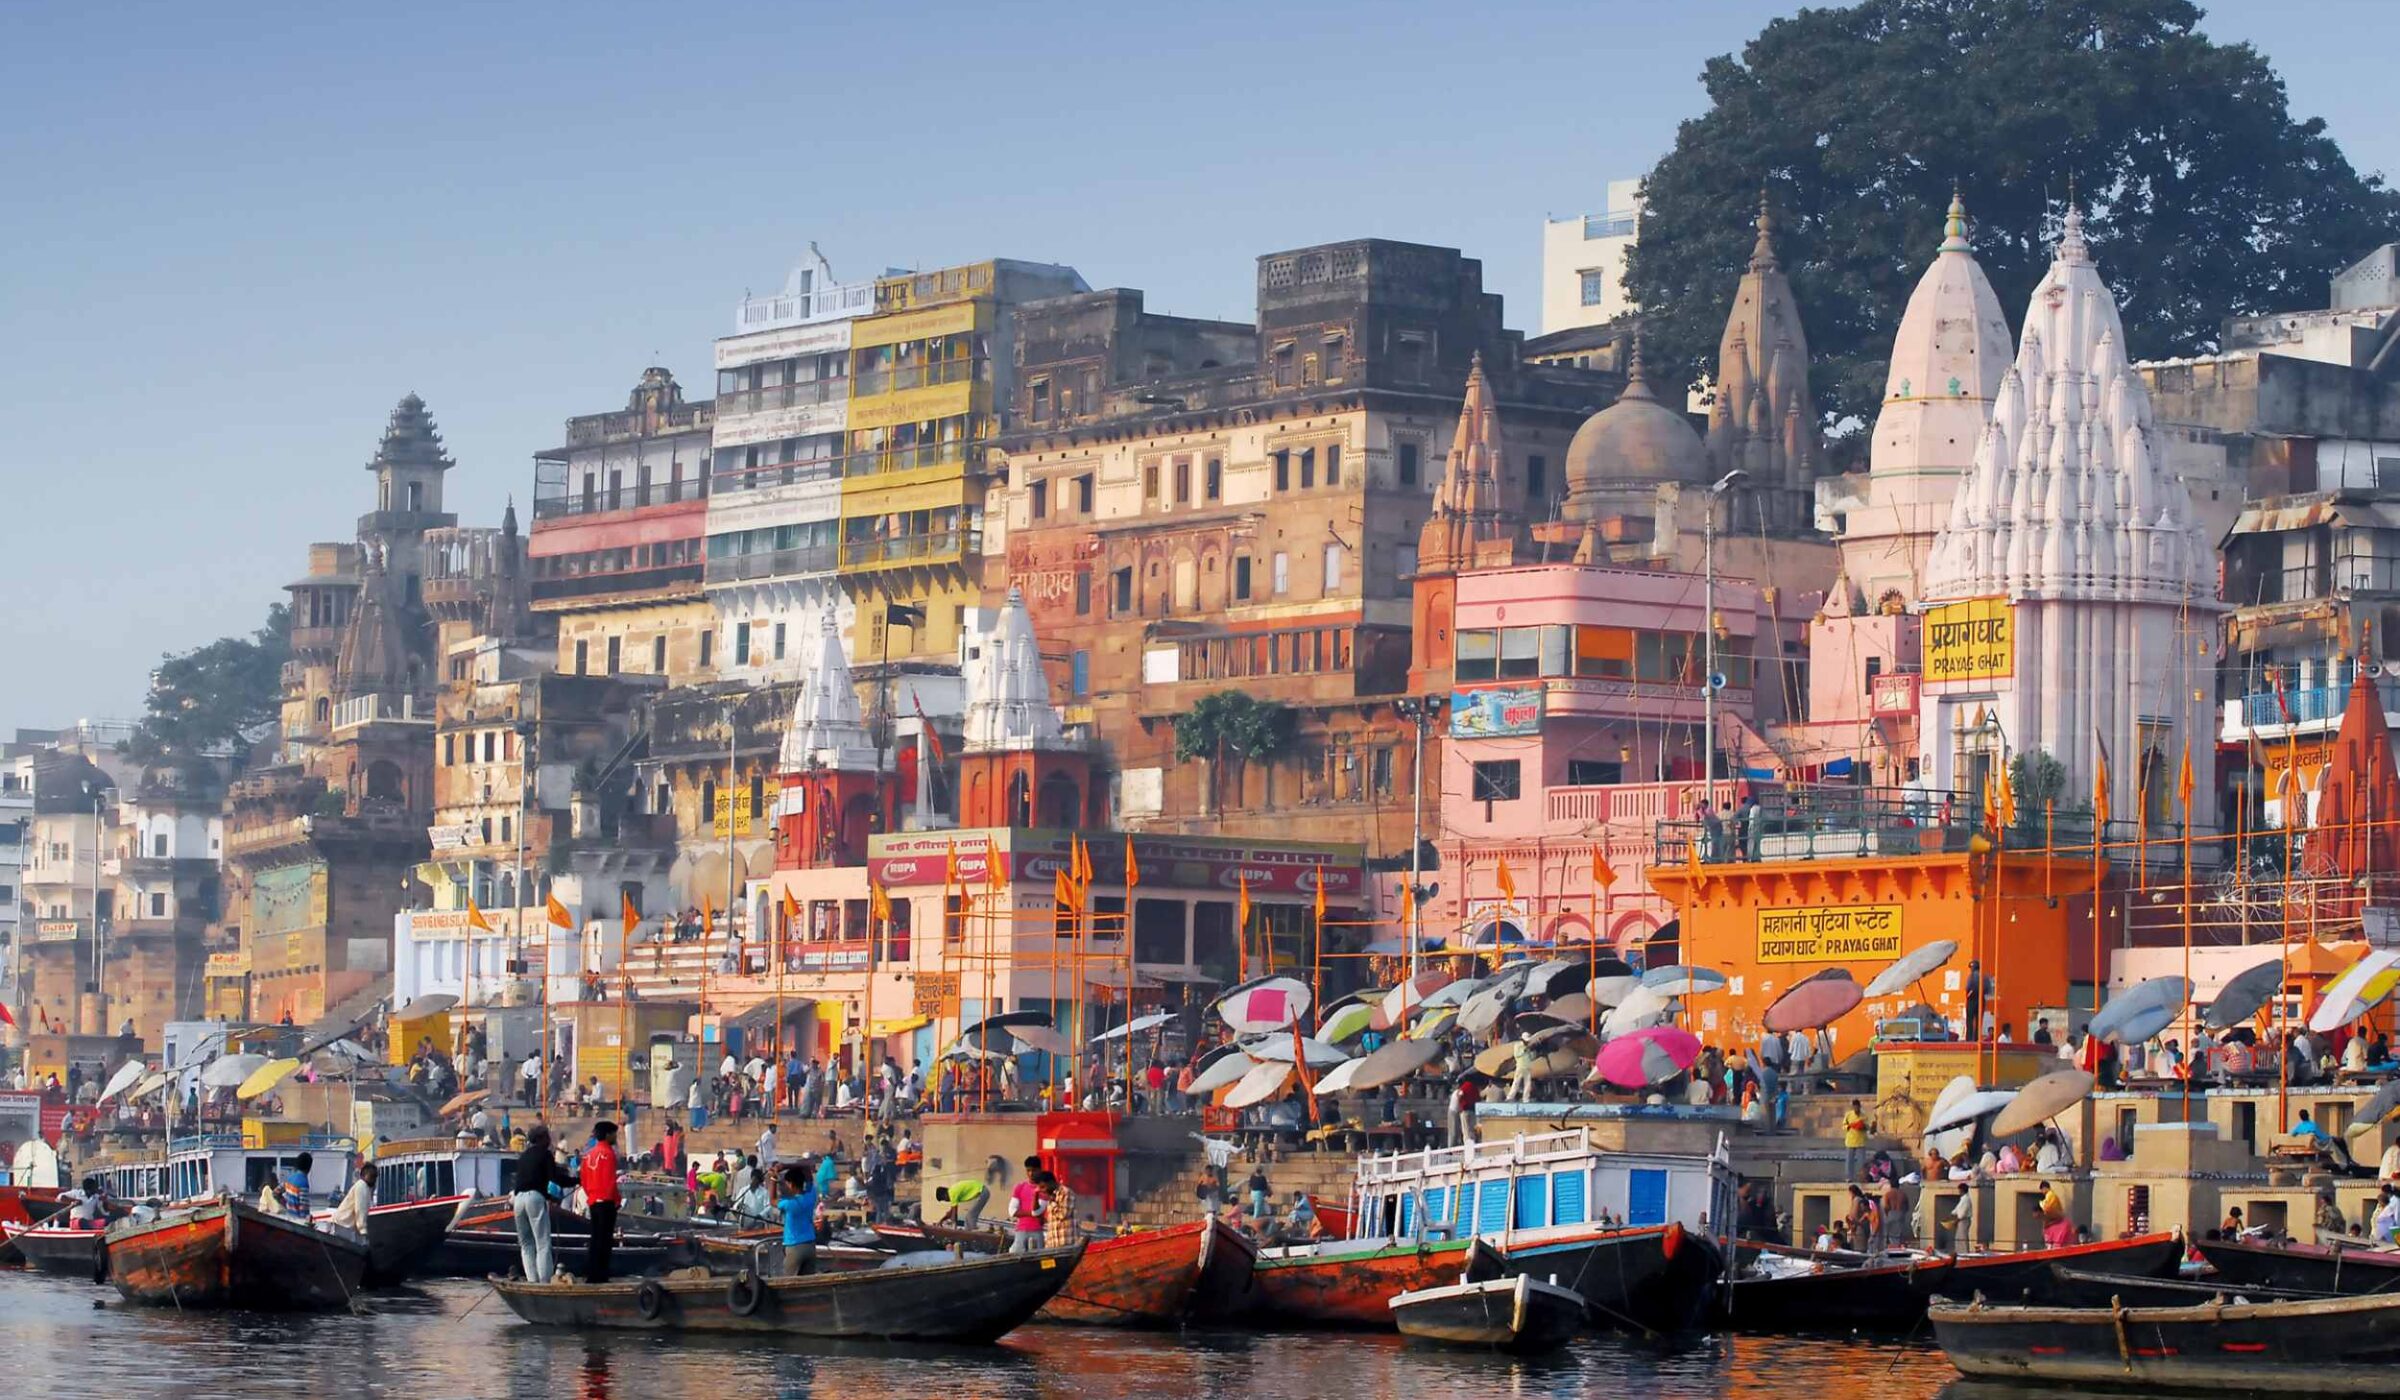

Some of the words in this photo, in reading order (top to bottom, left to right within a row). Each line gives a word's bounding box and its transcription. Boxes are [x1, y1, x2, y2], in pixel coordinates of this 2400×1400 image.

[1934, 656, 1973, 674] PRAYAG
[1978, 653, 2005, 670] GHAT
[890, 862, 917, 873] RUPA
[960, 859, 986, 871] RUPA
[1232, 869, 1273, 881] RUPA
[1826, 938, 1869, 954] PRAYAG
[1872, 937, 1899, 951] GHAT
